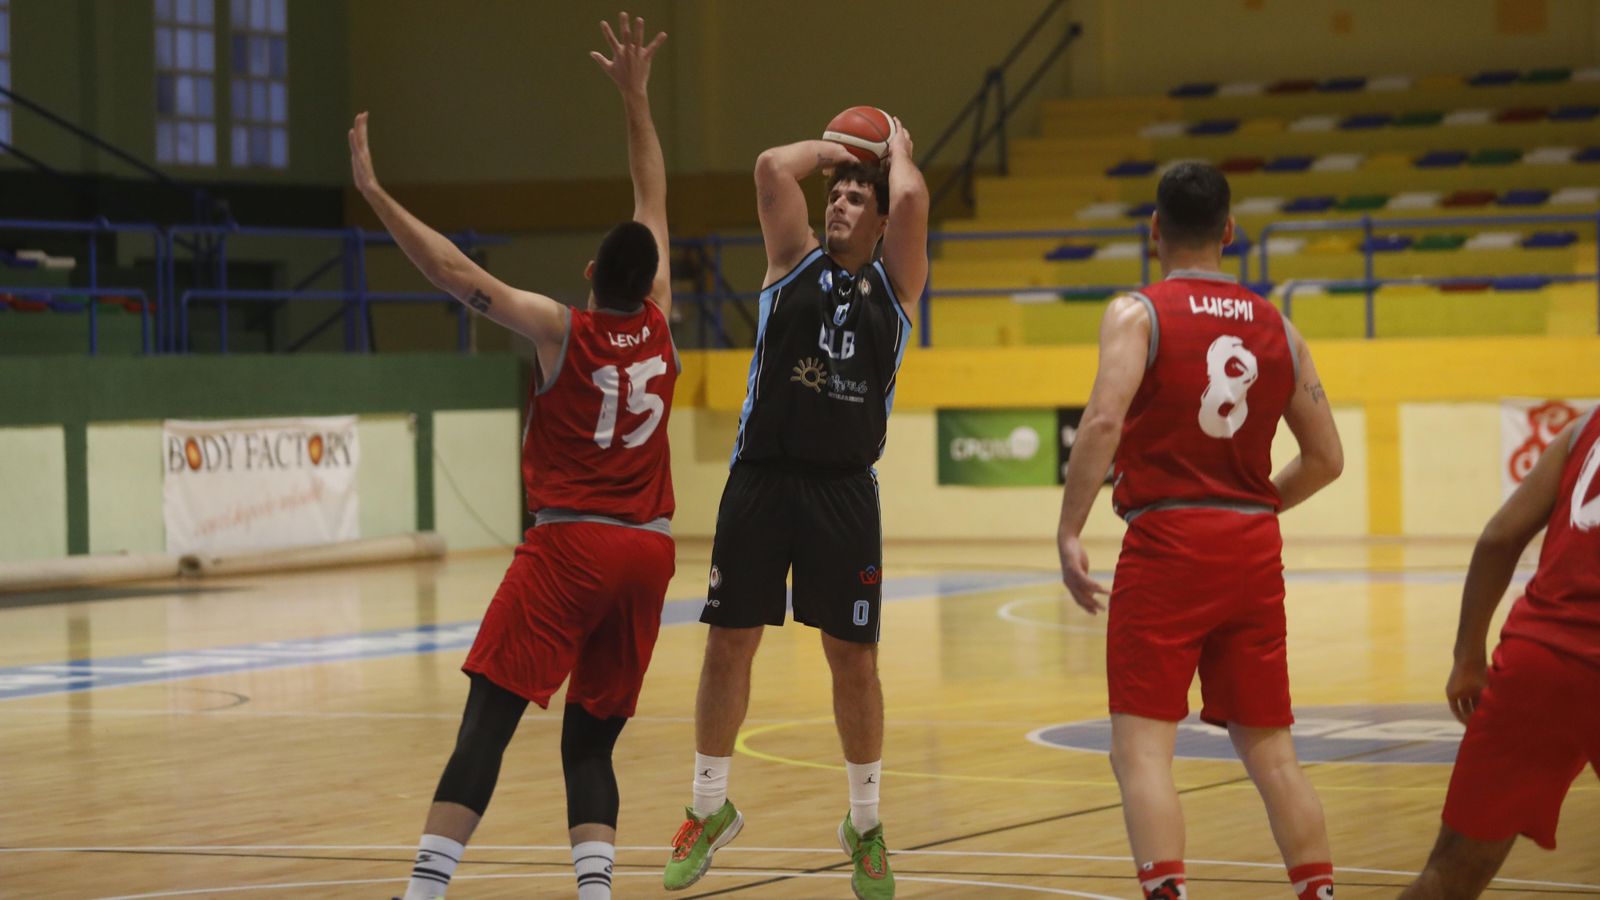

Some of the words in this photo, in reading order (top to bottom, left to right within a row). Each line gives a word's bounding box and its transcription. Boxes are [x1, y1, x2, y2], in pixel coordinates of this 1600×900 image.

[1189, 295, 1254, 321] LUISMI
[592, 354, 667, 450] 15
[1198, 335, 1258, 439] 8
[169, 435, 237, 472] BODY
[245, 431, 354, 470] FACTORY
[853, 600, 869, 626] 0
